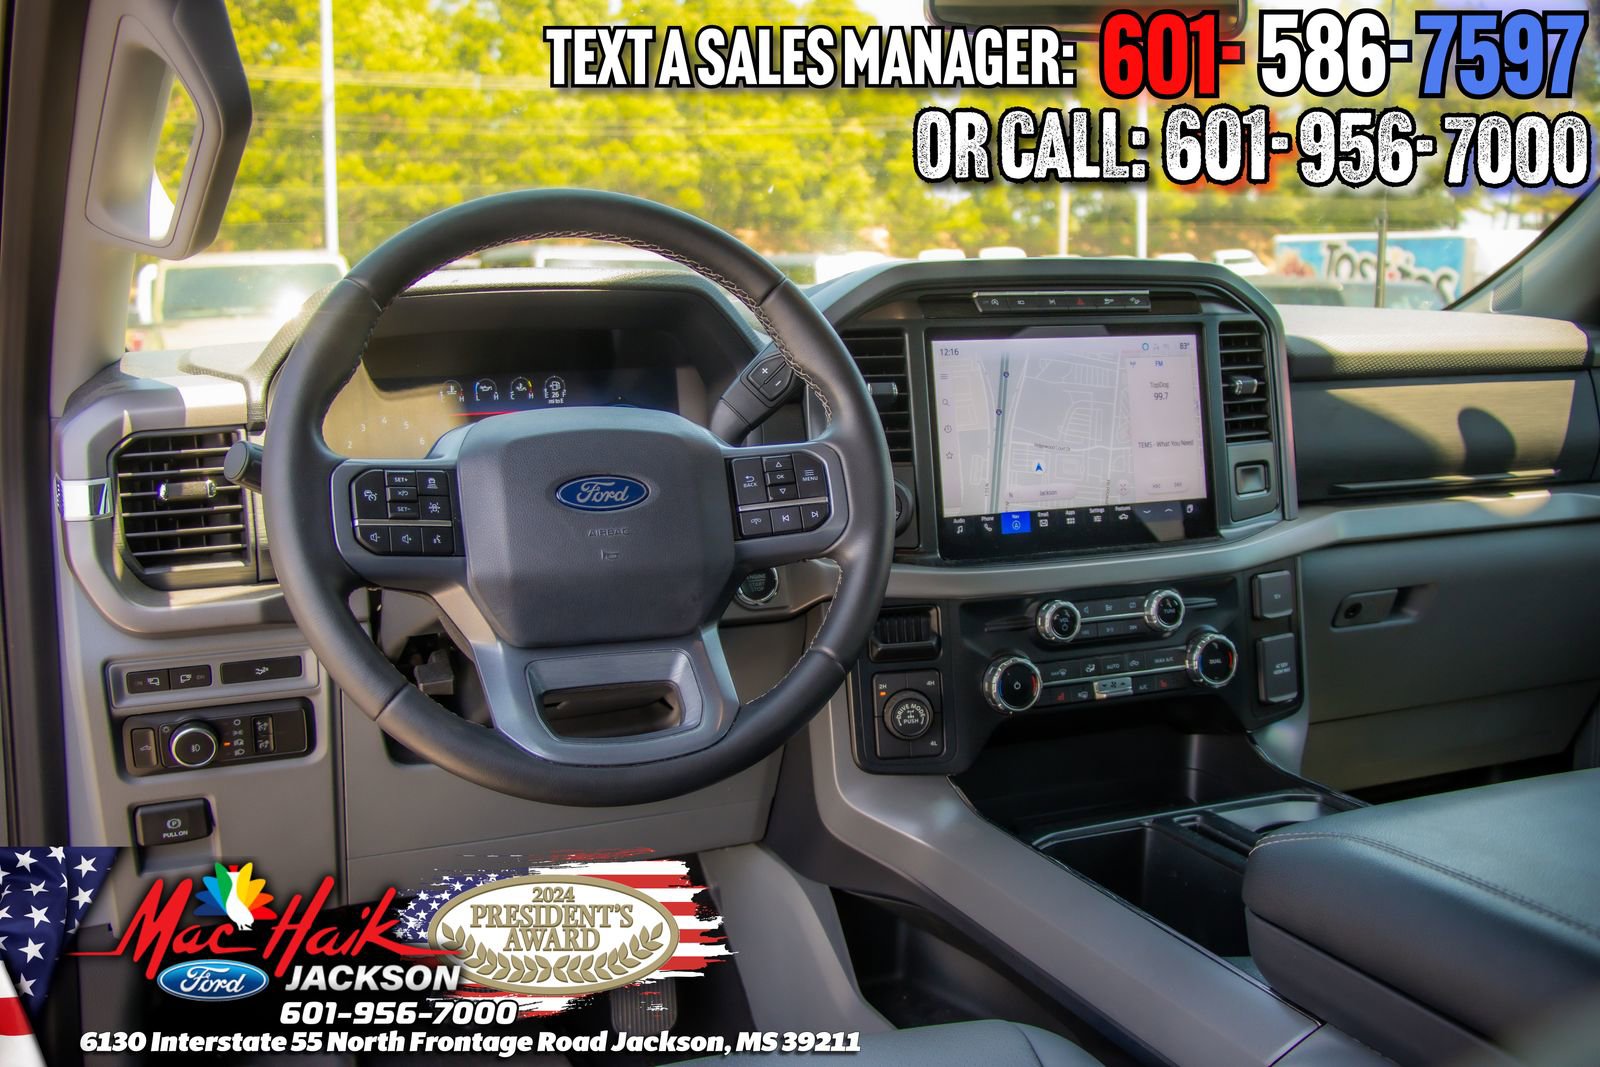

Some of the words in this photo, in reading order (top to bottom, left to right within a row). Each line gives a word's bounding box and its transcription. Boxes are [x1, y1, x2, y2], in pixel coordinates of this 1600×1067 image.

[940, 348, 960, 356] 12:16
[1154, 392, 1169, 400] 99.7
[347, 440, 353, 449] 2
[576, 481, 630, 503] Ford
[587, 528, 631, 537] AIRBAG
[896, 703, 910, 720] DRIVE
[911, 703, 926, 718] MODE
[162, 831, 178, 839] PULL
